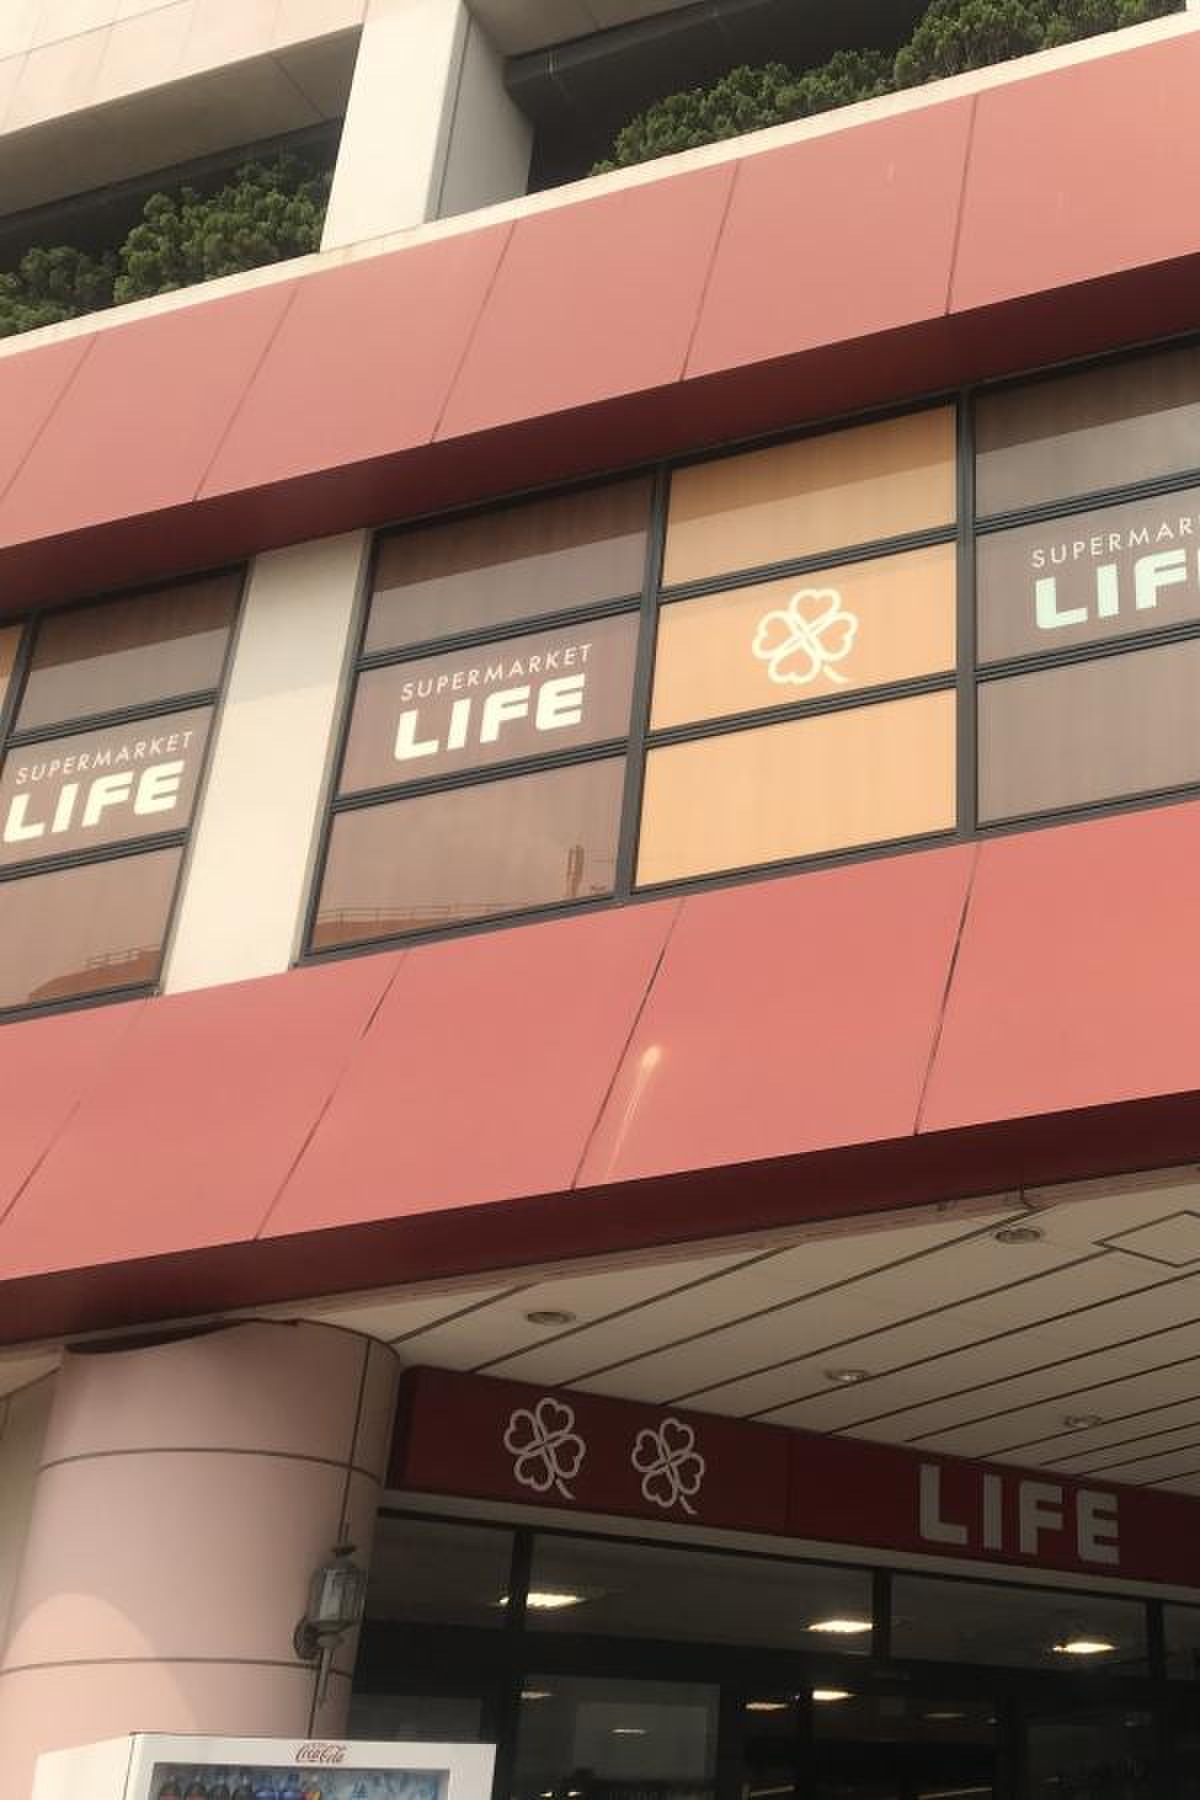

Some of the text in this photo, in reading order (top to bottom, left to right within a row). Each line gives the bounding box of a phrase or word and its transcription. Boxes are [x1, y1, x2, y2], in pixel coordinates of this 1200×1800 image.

[401, 643, 593, 700] SUPERMARKET
[15, 730, 194, 785] SUPERMARKET
[393, 674, 586, 761] LIFE
[3, 760, 184, 843] LIFE
[918, 1463, 1121, 1565] LIFE
